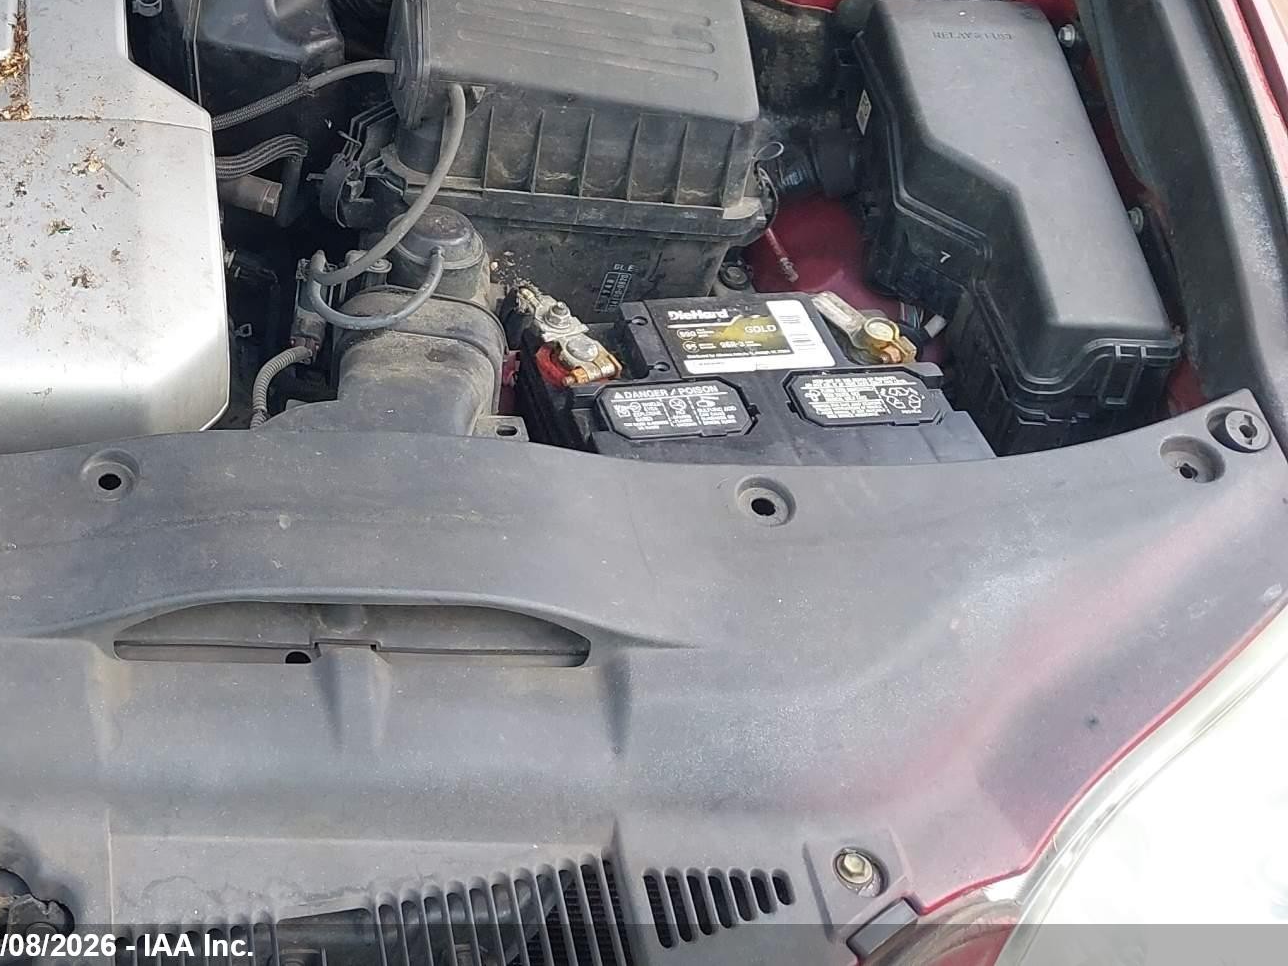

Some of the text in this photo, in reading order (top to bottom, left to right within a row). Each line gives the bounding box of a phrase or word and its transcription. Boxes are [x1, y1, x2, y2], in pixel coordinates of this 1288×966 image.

[667, 308, 729, 321] DieHard
[744, 324, 777, 334] GOLD
[623, 390, 669, 399] DANGER
[678, 386, 719, 395] POISON
